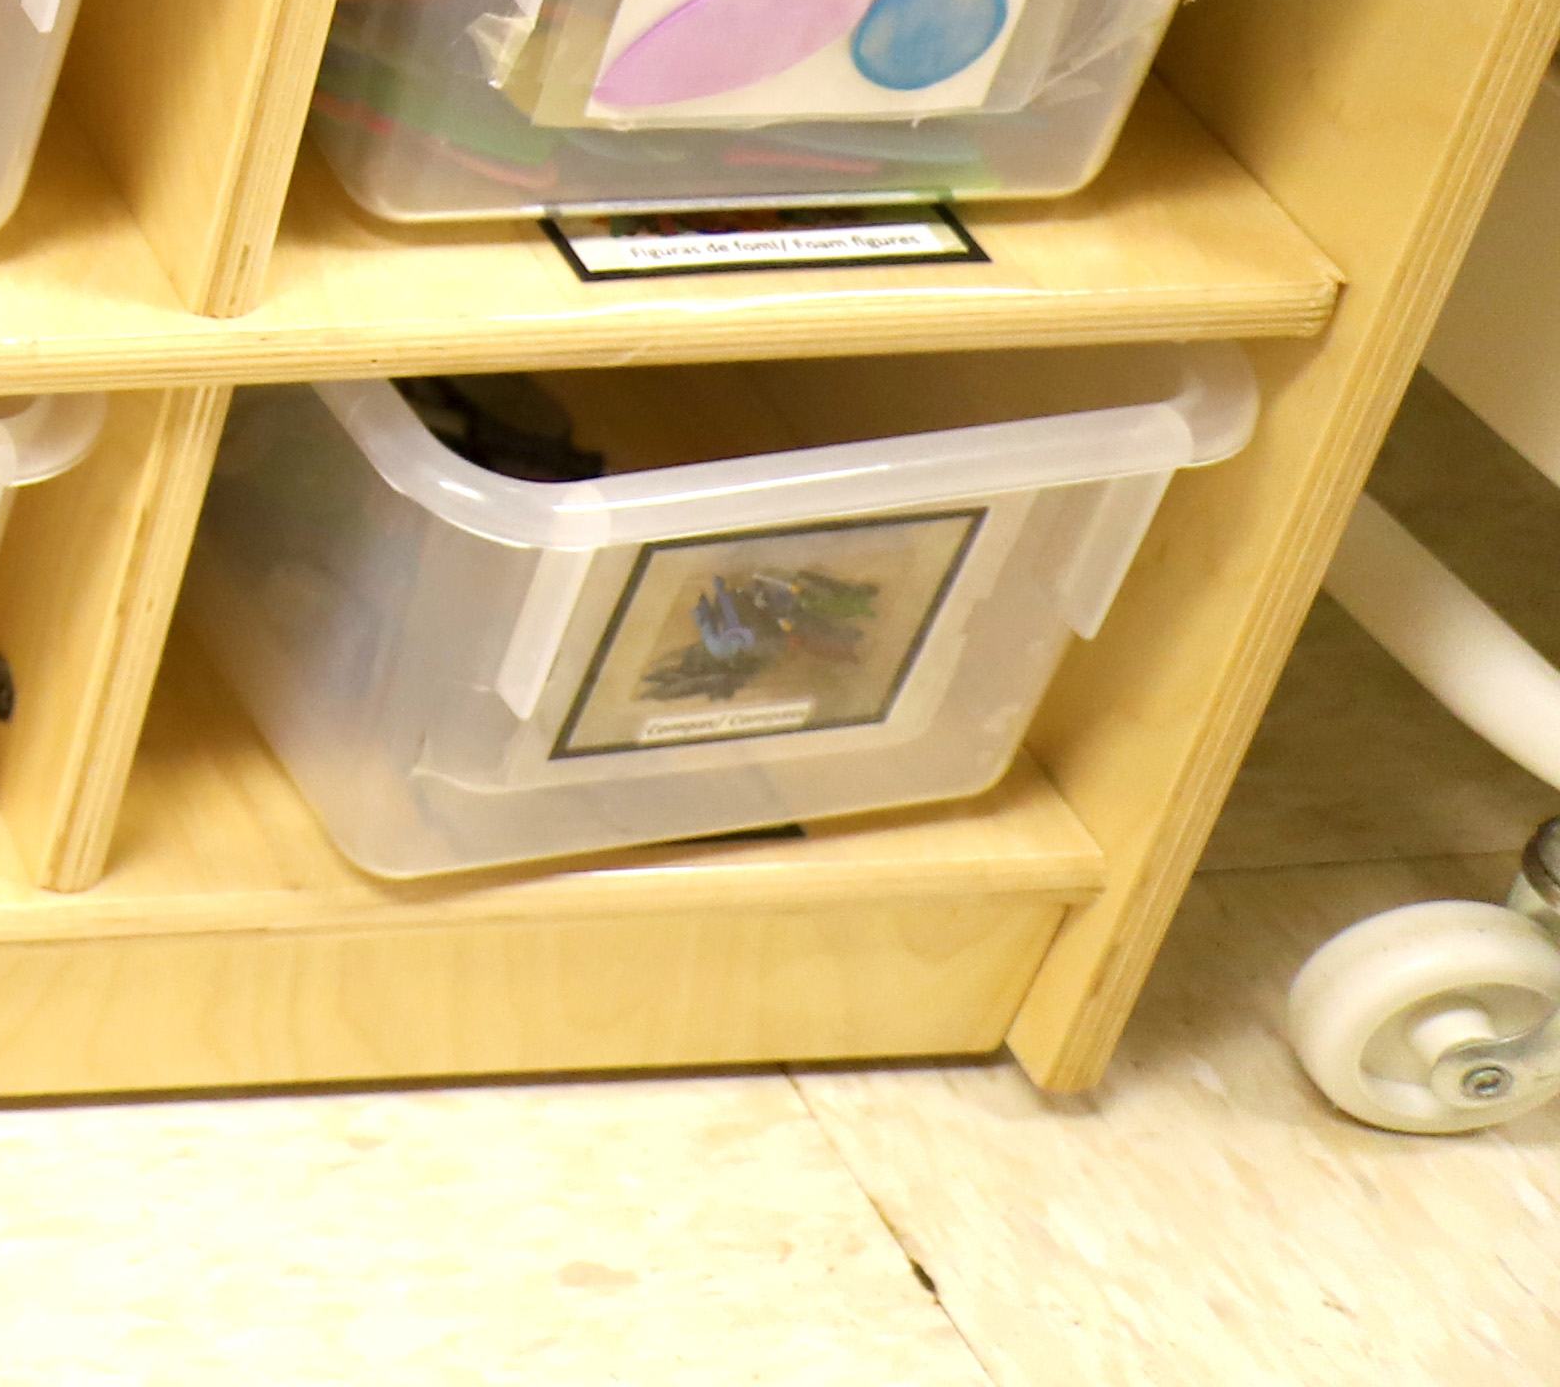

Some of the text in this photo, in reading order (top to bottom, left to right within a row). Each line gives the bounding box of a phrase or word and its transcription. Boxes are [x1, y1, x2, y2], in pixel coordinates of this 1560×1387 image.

[629, 246, 701, 259] Figuras
[707, 243, 729, 253] de
[852, 233, 920, 248] figures
